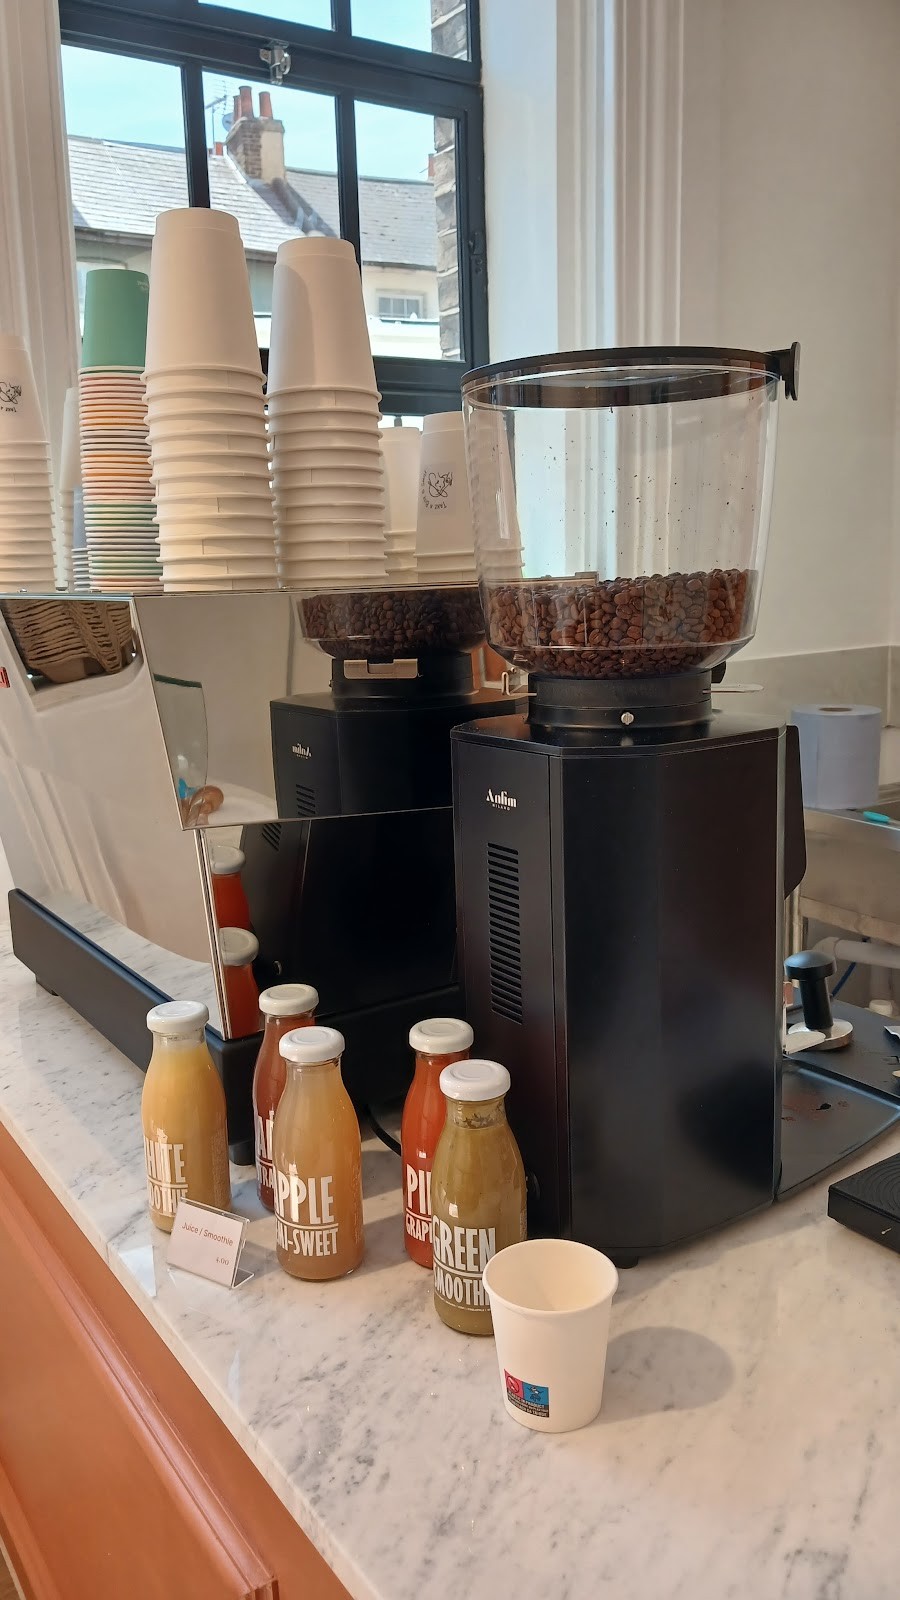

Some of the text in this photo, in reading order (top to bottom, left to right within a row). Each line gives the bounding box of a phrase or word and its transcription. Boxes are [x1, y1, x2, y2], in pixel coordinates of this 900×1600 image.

[486, 788, 517, 808] Anfim
[181, 1222, 199, 1234] Juice
[203, 1229, 234, 1247] Smoothie
[433, 1214, 496, 1272] GREEN
